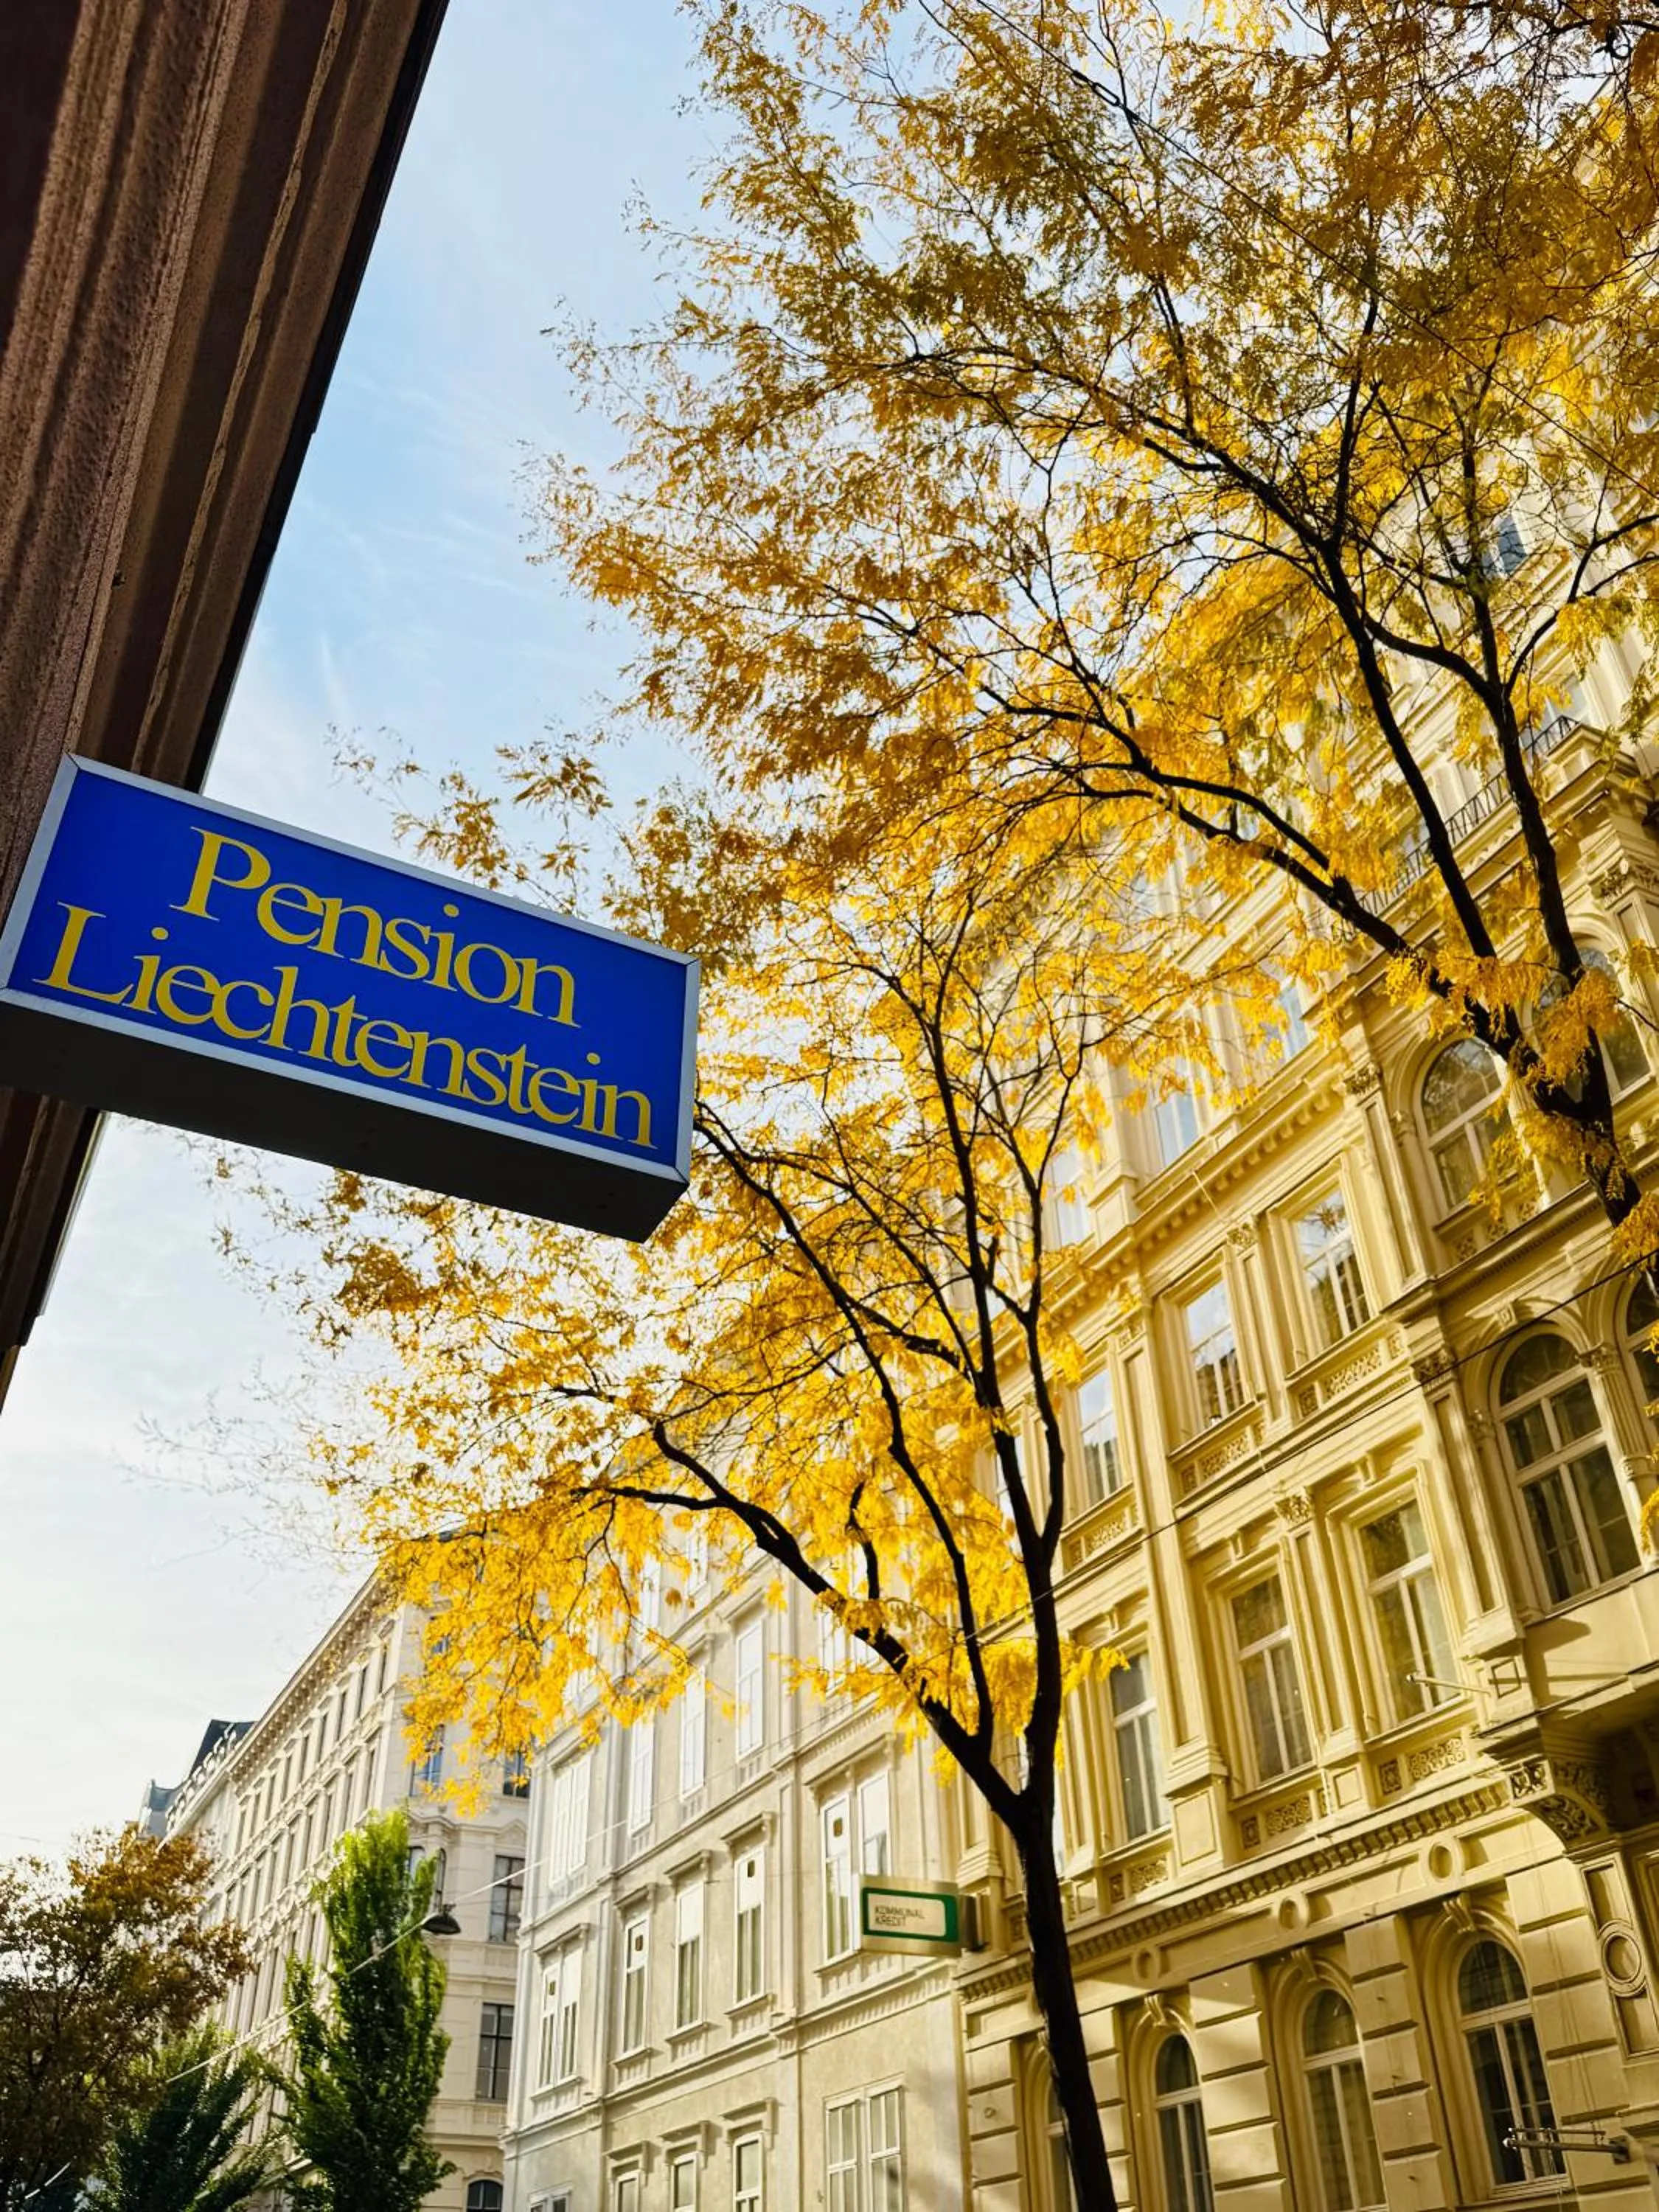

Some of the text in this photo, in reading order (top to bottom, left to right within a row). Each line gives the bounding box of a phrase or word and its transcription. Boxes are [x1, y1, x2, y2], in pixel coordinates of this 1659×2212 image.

[170, 826, 581, 1028] Pension
[32, 901, 659, 1150] Liechtenstein
[874, 1905, 925, 1919] KOMMUNAL
[874, 1916, 905, 1927] KREDIT
